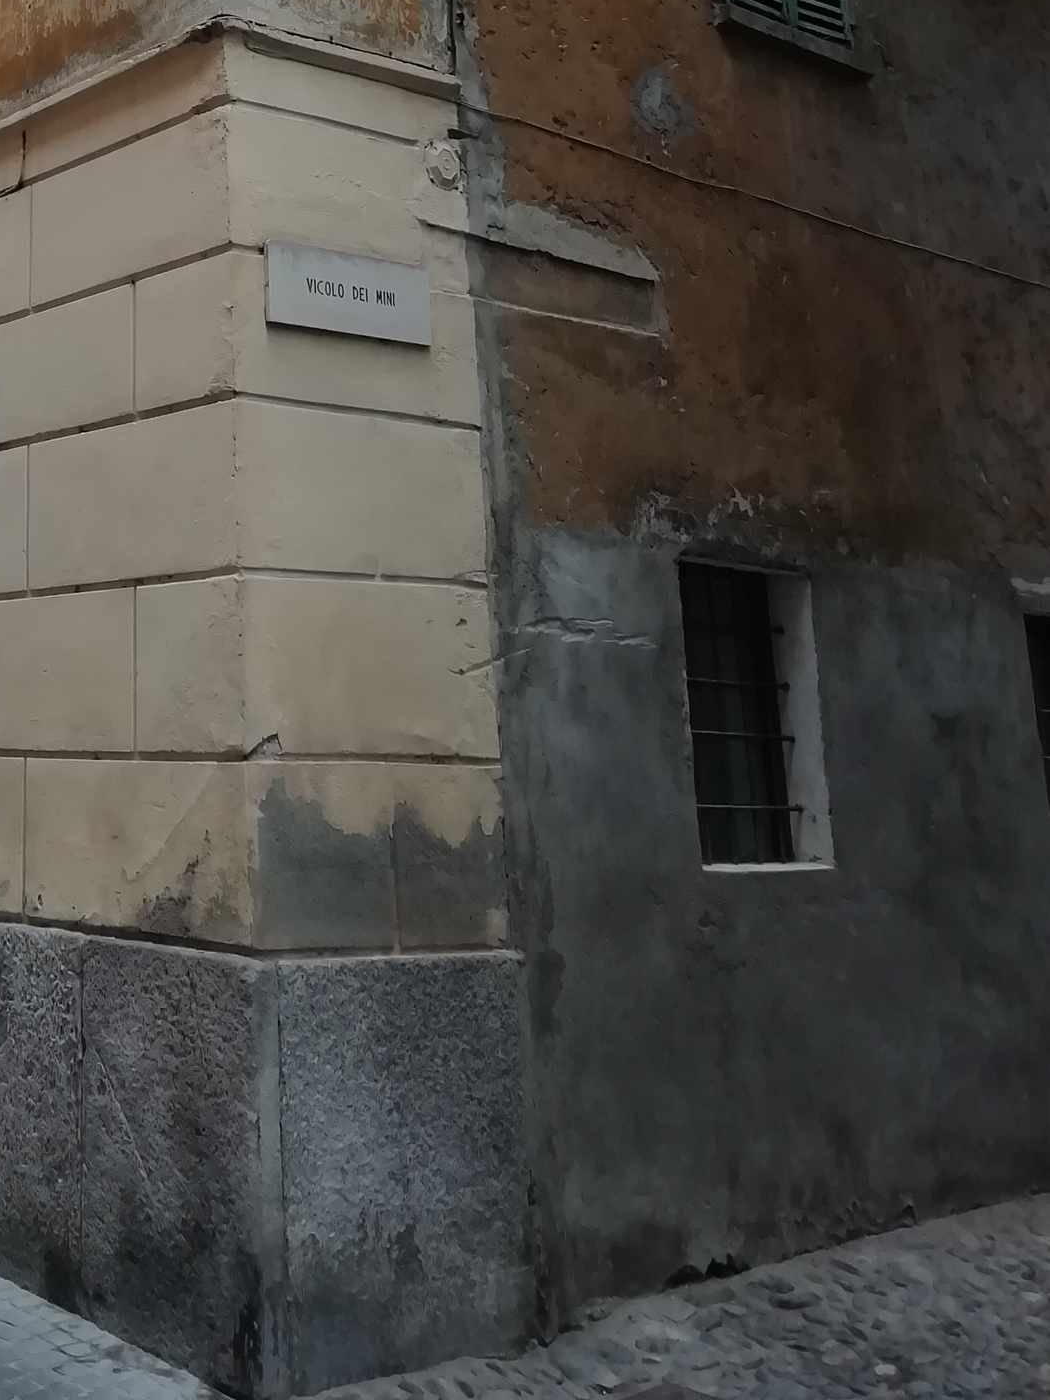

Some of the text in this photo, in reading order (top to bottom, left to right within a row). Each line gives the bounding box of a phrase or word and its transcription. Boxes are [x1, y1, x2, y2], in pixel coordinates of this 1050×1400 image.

[306, 277, 396, 307] VICOLO DEI MINI
